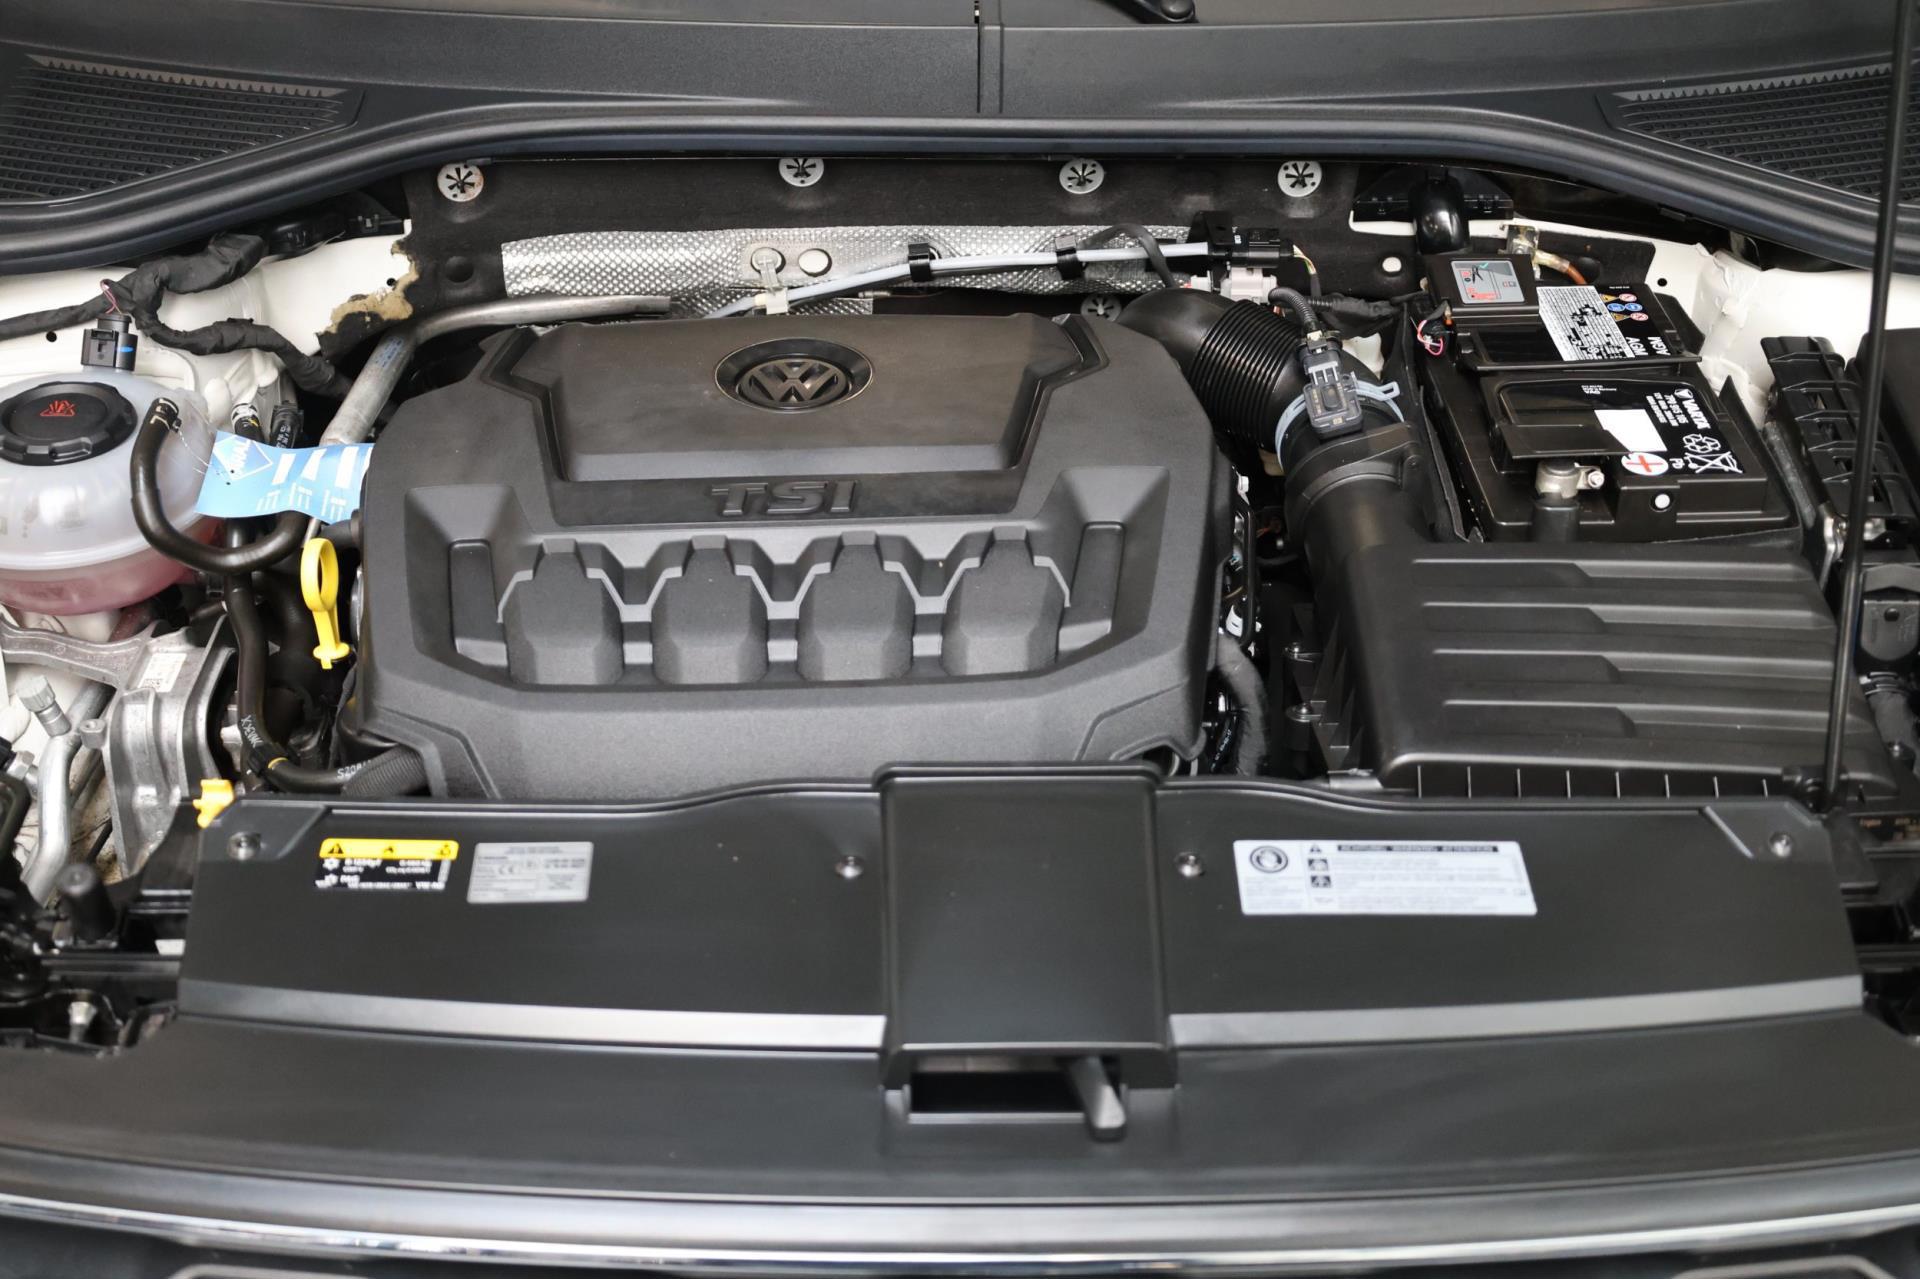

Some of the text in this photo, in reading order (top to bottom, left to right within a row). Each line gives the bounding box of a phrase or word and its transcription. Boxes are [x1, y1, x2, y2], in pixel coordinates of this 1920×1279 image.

[1625, 336, 1648, 356] AGM
[1648, 336, 1671, 356] AGM
[1682, 398, 1711, 430] VARTA
[710, 481, 858, 516] TSI
